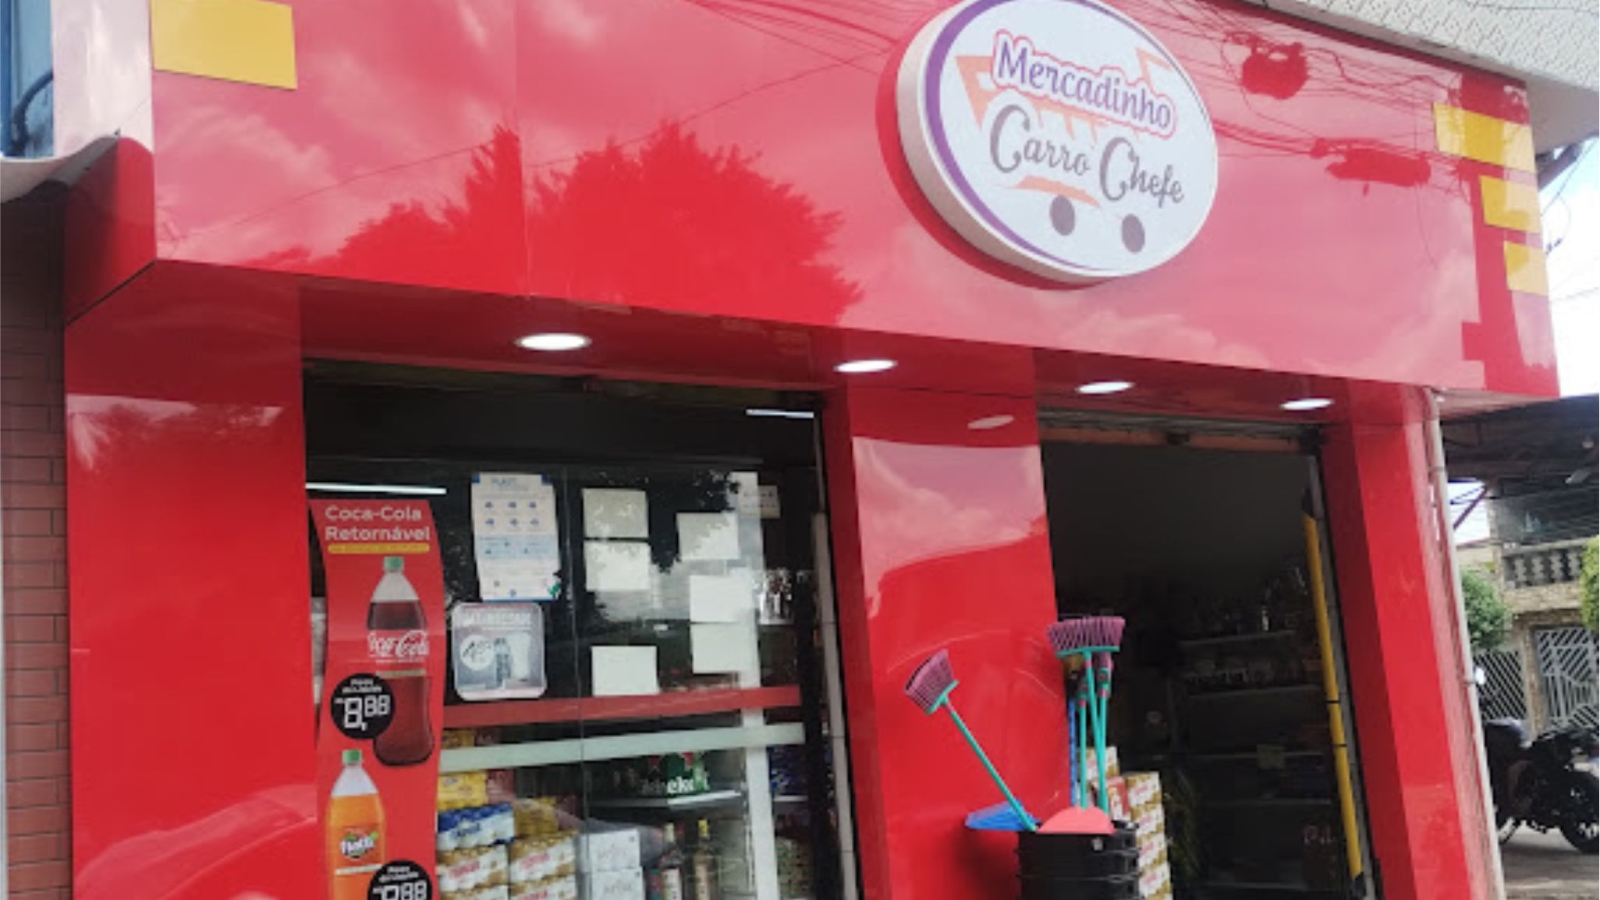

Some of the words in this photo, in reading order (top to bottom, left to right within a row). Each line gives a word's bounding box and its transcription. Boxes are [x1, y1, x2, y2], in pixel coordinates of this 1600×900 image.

[997, 40, 1172, 130] Mercadinho
[989, 104, 1091, 176] Carro
[1099, 136, 1184, 209] Chefe
[324, 525, 431, 541] Retornável
[325, 504, 422, 521] Coca-Cola
